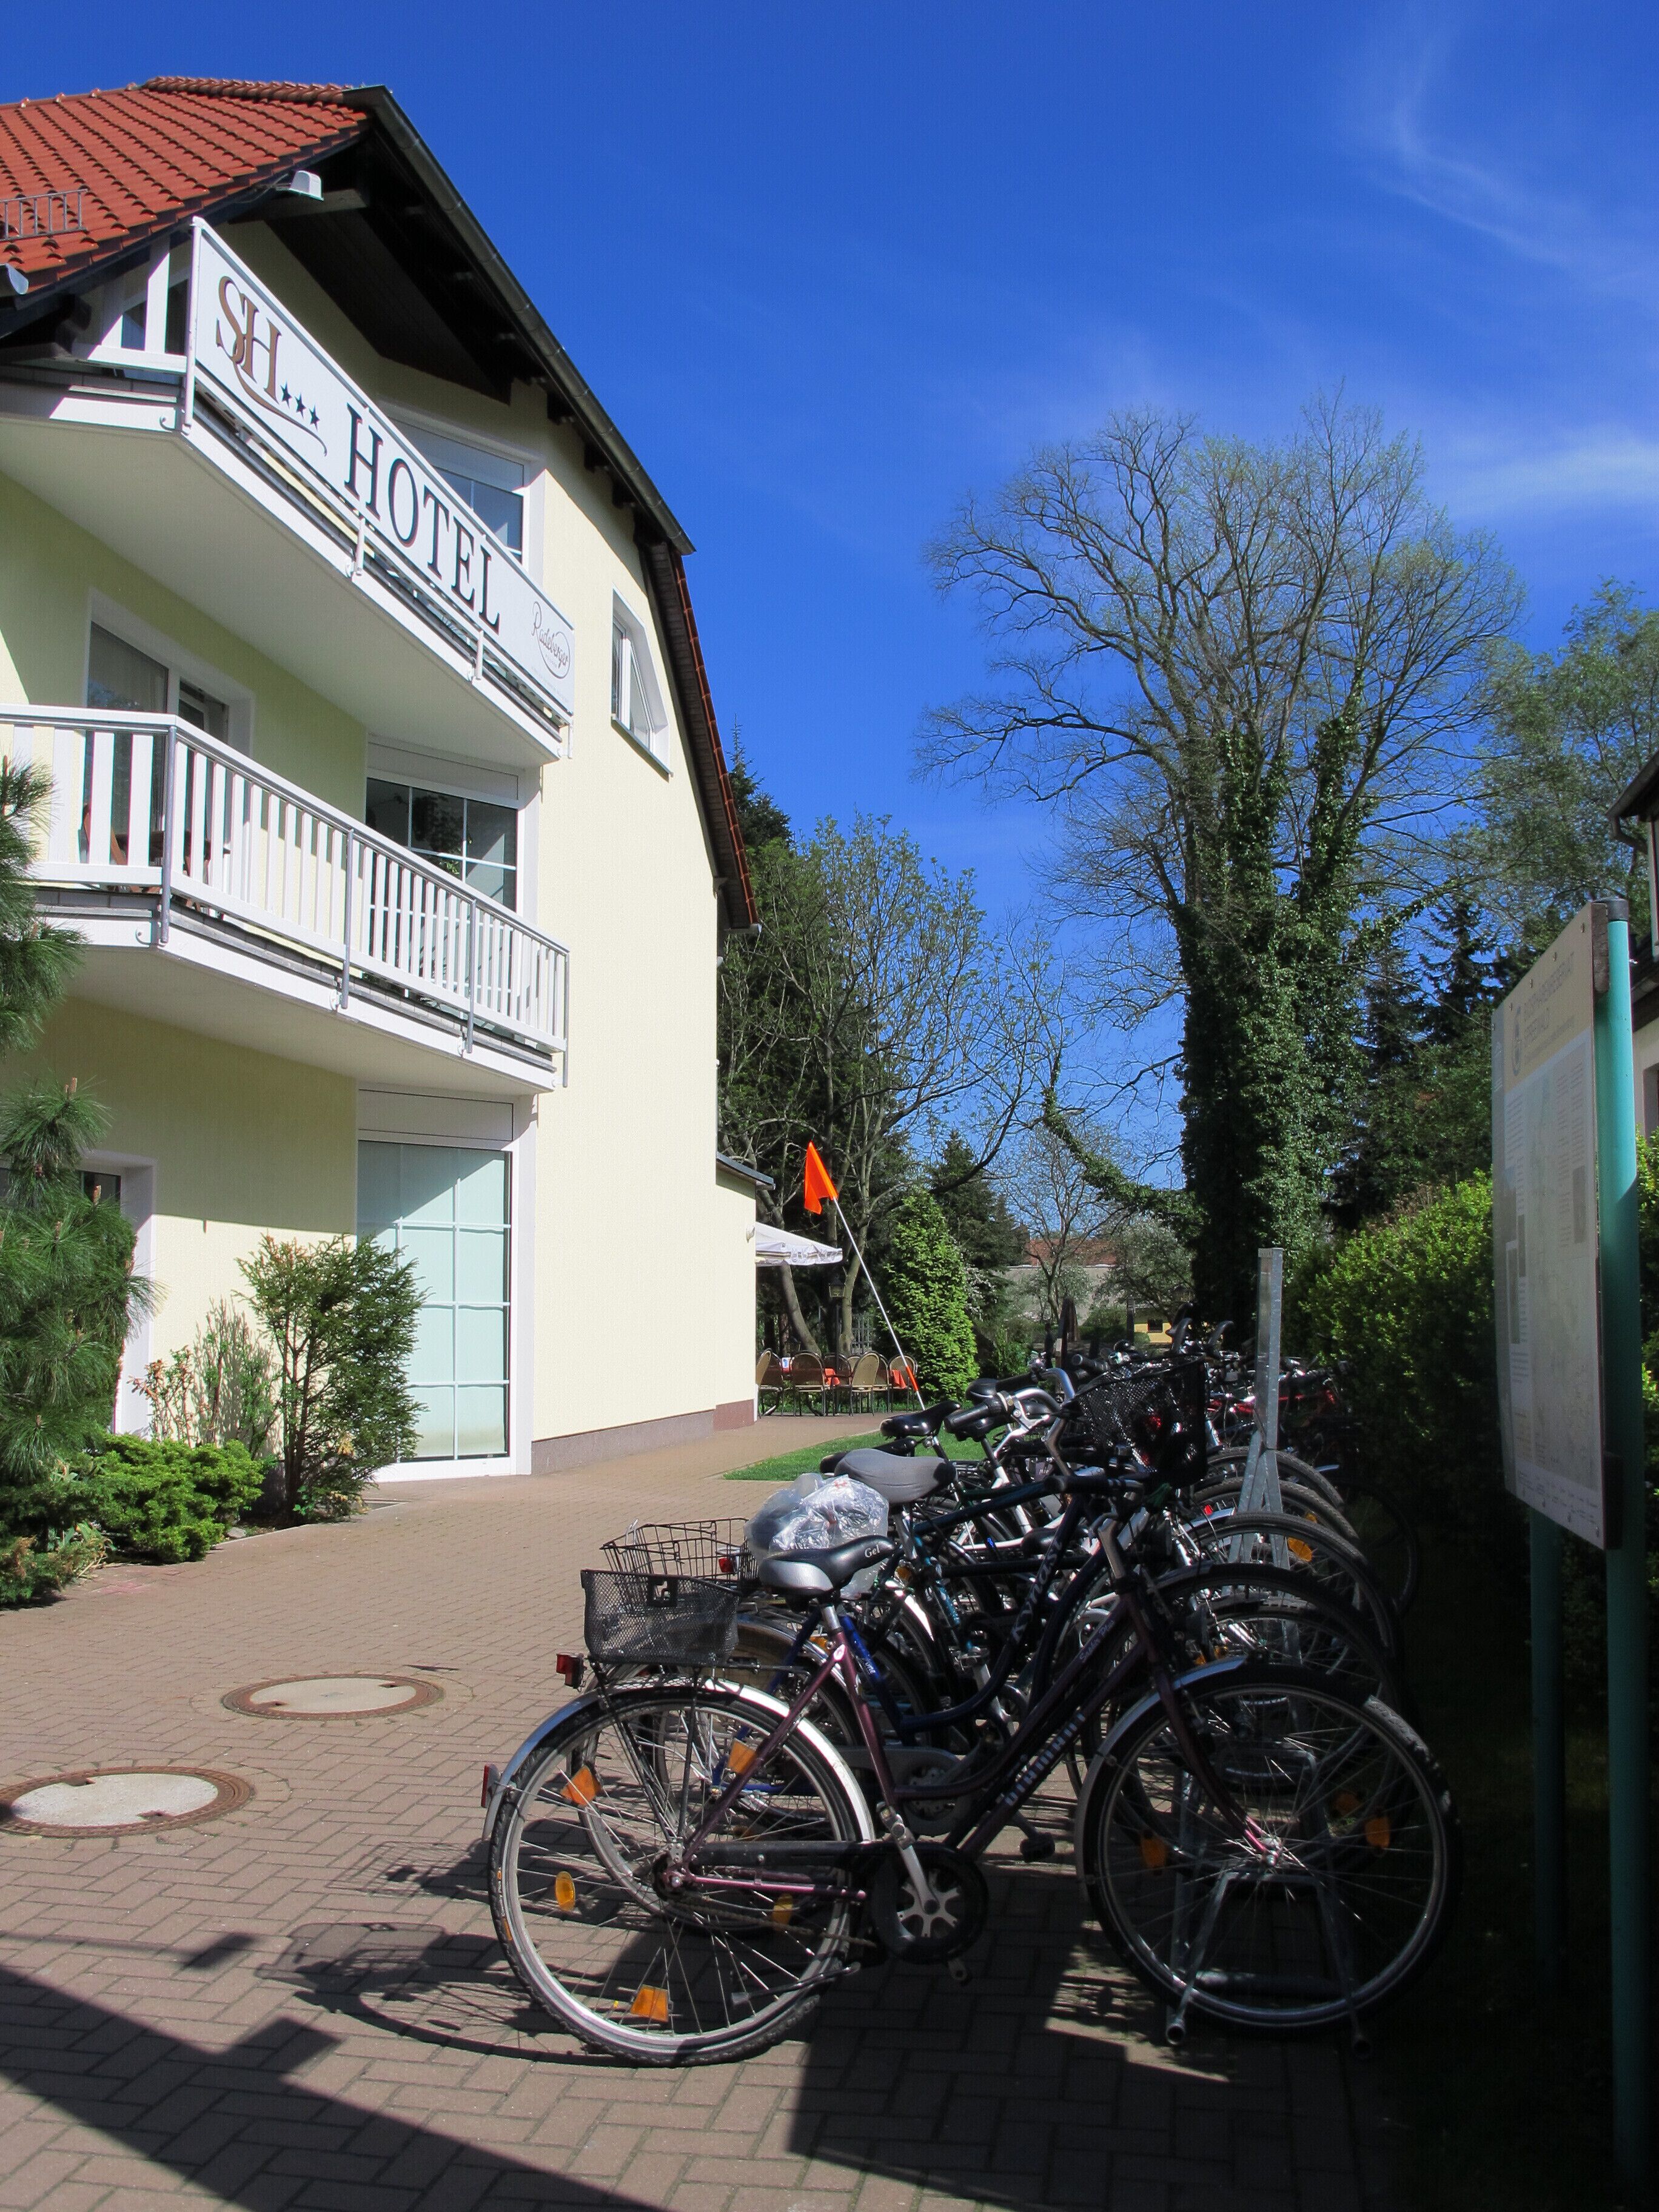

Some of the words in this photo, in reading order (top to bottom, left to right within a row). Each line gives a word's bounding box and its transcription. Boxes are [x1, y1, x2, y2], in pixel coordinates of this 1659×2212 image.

[344, 403, 501, 634] HOTEL
[532, 601, 569, 669] Radeberger
[864, 1544, 880, 1558] Gel
